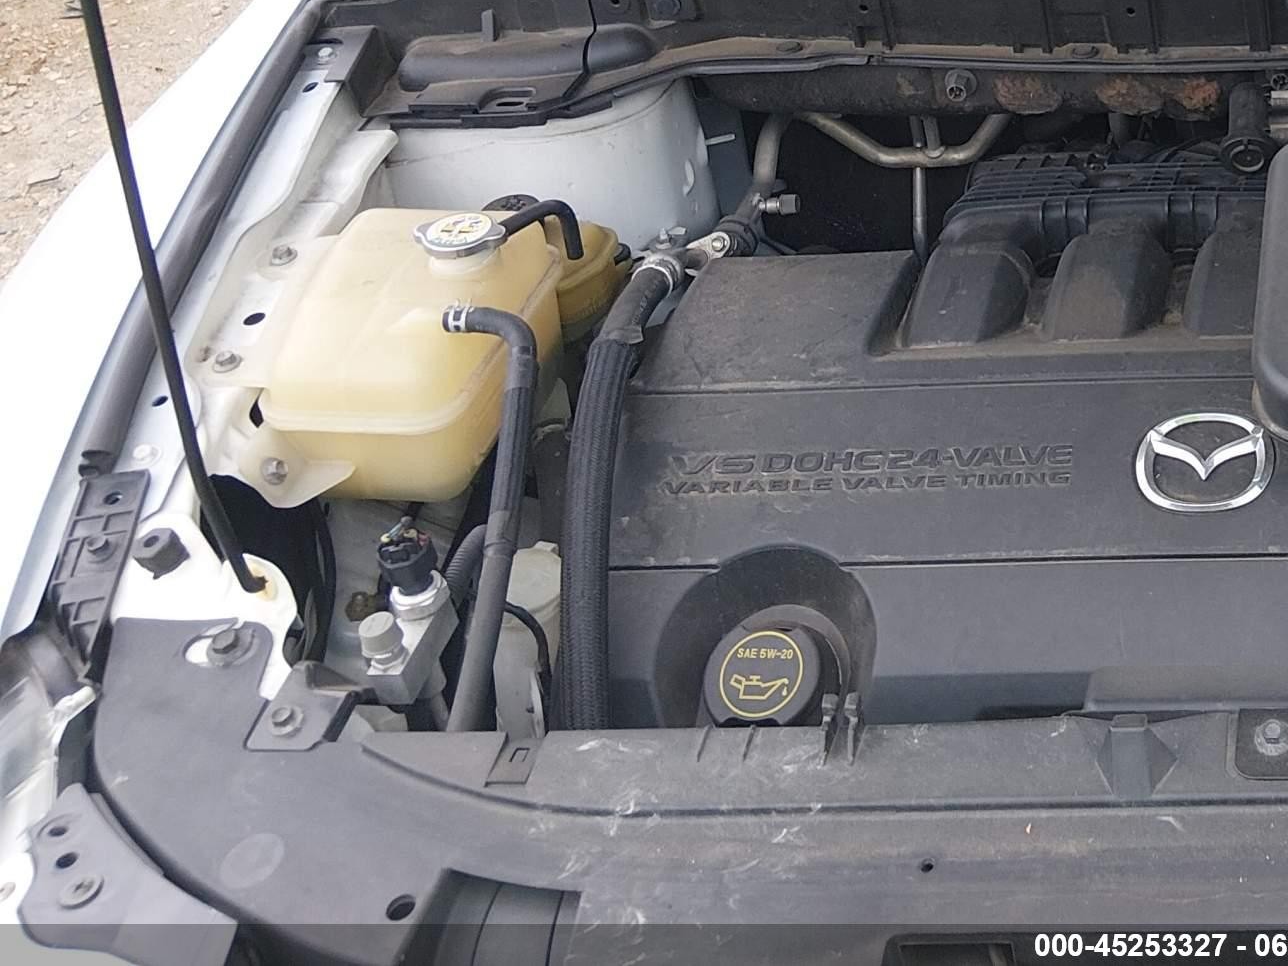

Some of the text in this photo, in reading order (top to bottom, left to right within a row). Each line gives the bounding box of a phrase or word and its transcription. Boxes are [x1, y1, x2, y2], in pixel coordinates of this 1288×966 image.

[670, 452, 756, 476] V6
[761, 449, 884, 474] DOHC
[662, 471, 1072, 495] VARIABLE VALVE TIMING
[737, 648, 794, 660] SAE 5W-20
